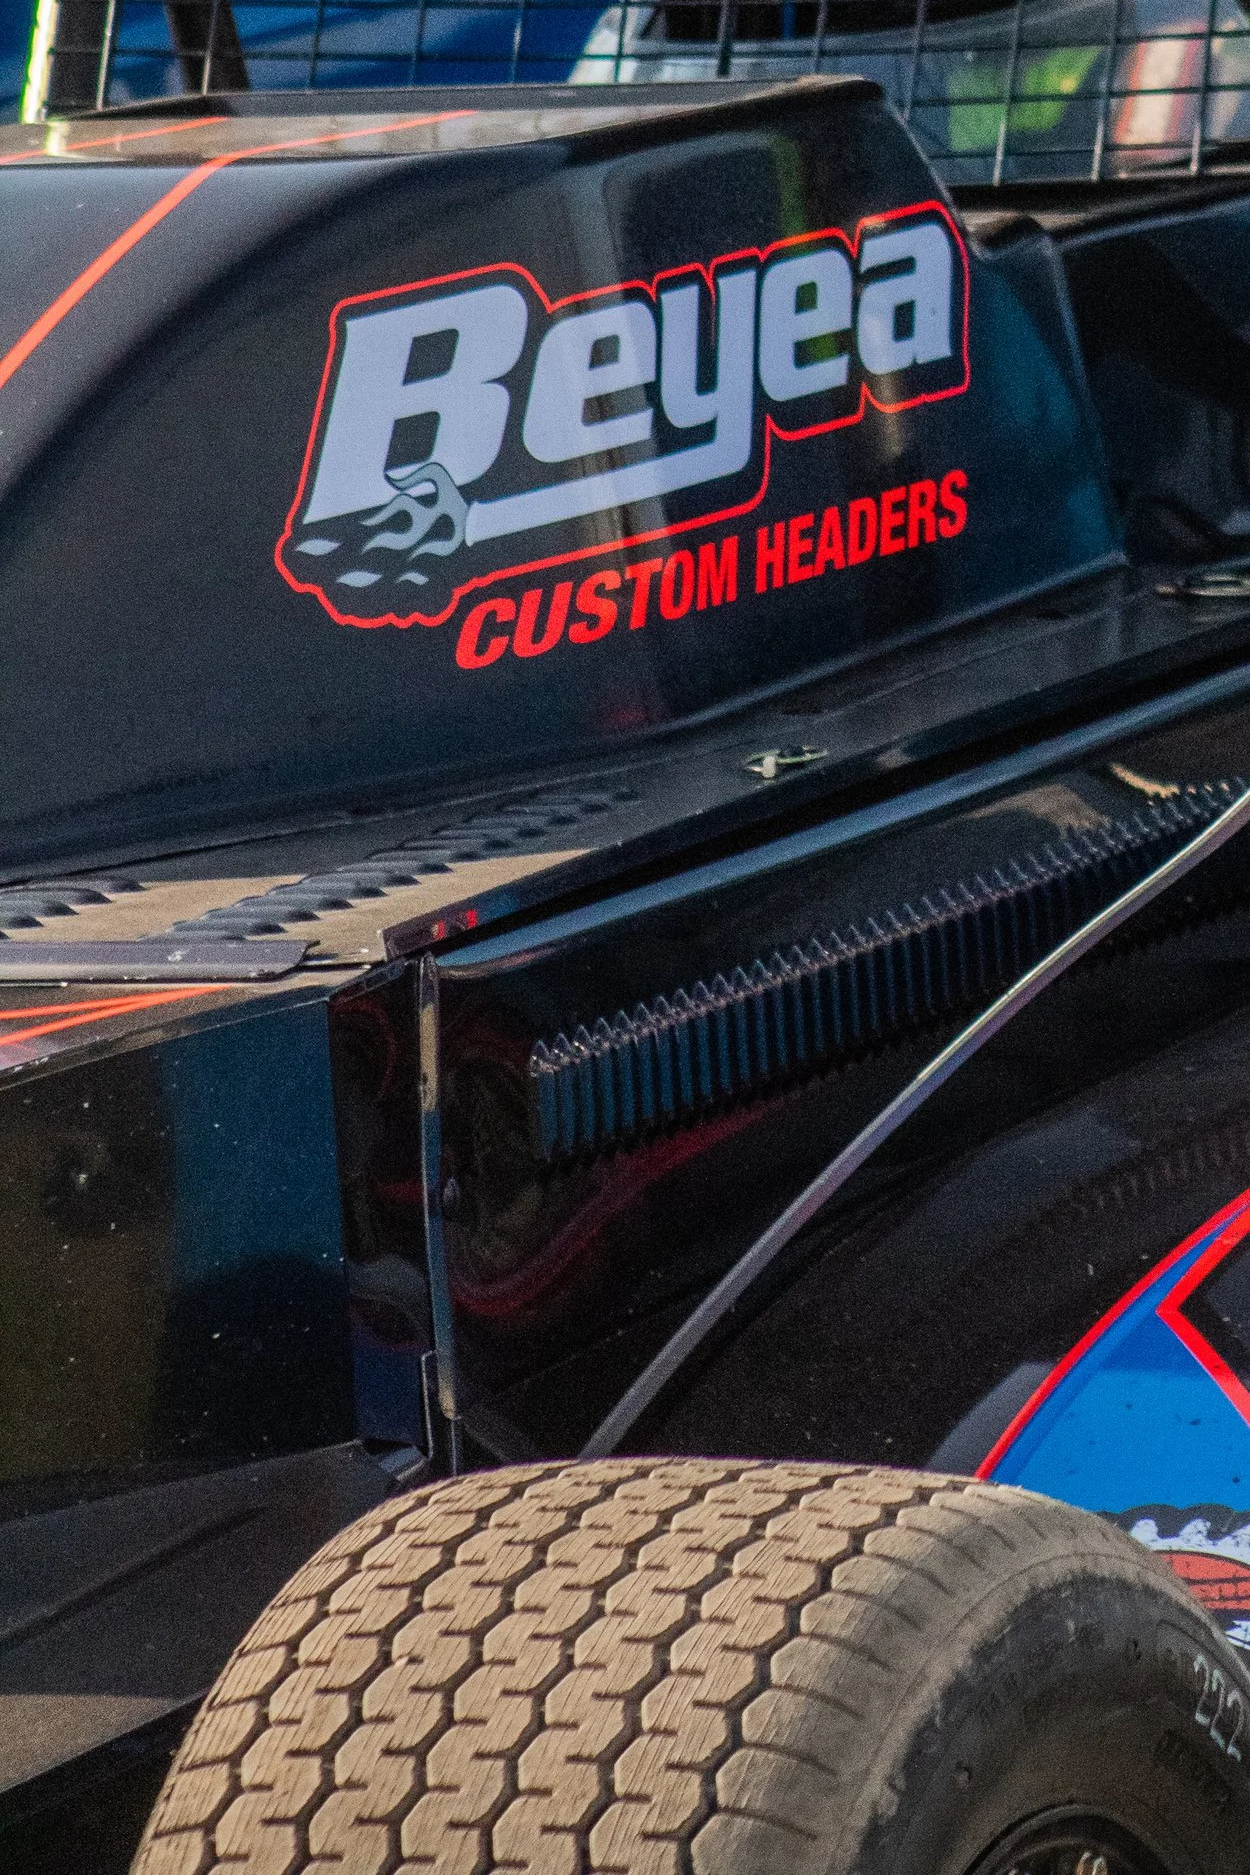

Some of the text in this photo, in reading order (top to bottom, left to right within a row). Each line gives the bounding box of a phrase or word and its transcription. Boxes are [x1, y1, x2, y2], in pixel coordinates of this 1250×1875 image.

[302, 221, 954, 549] Beyea
[455, 468, 969, 671] CUSTOM HEADERS
